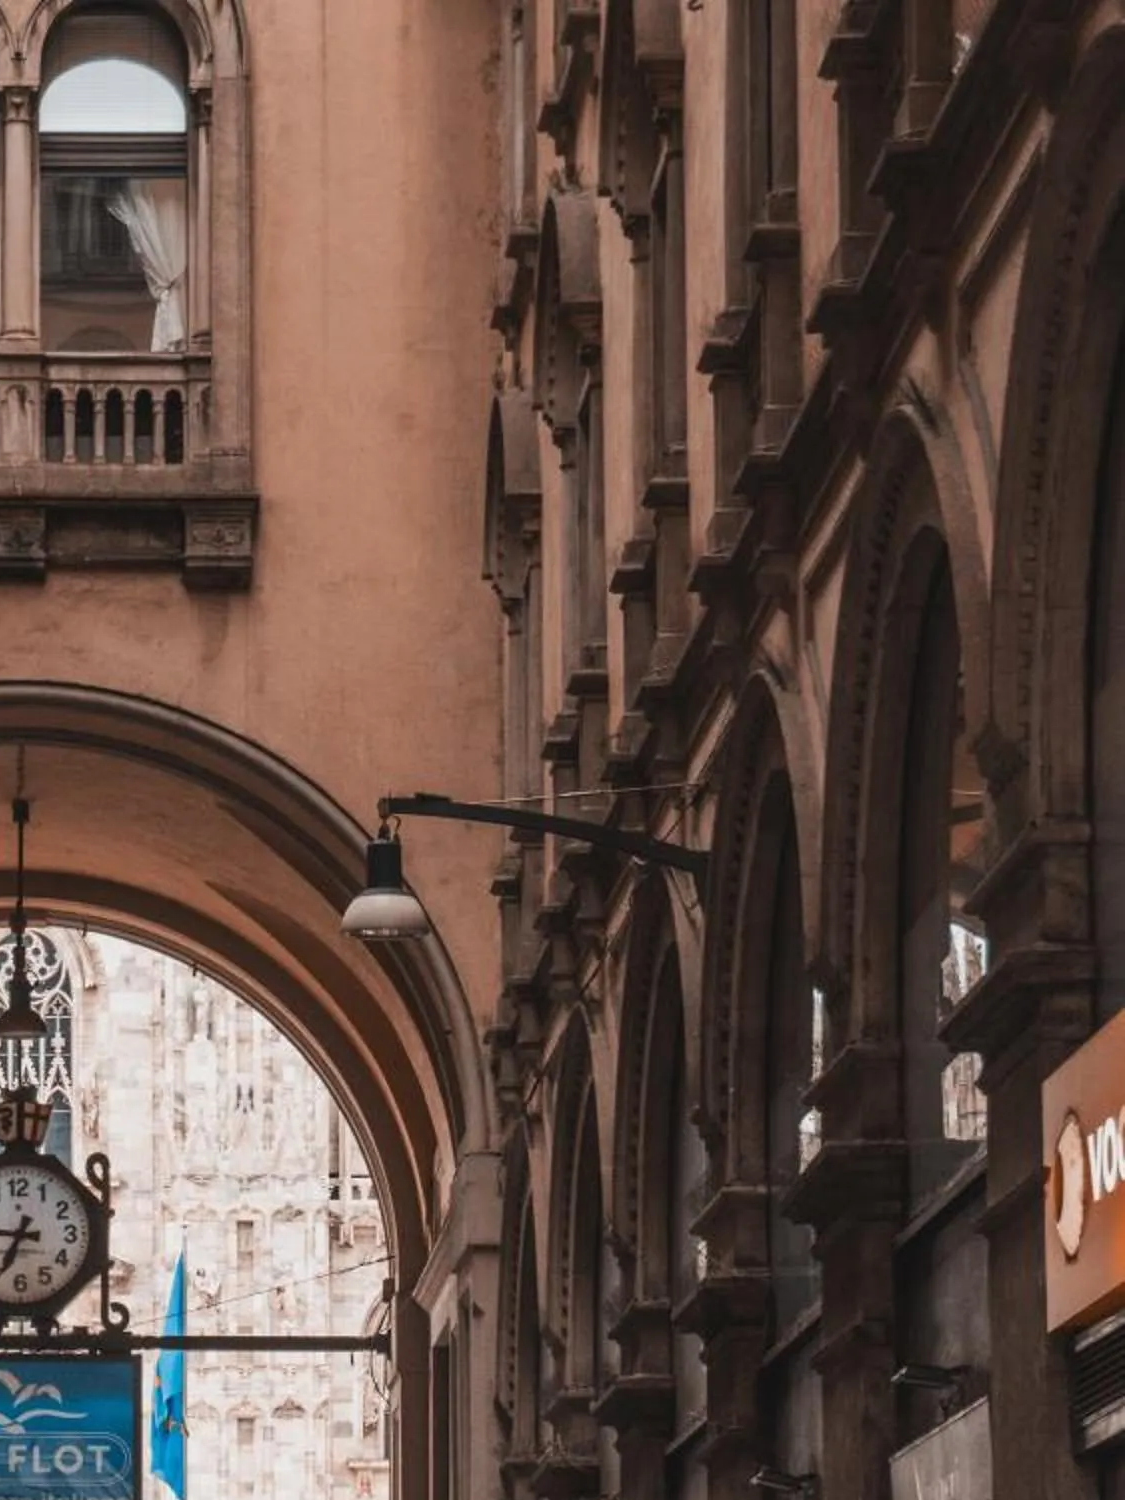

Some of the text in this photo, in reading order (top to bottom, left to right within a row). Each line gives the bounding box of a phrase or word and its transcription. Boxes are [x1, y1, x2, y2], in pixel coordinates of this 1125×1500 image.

[8, 1178, 28, 1197] 12
[38, 1183, 46, 1201] 1
[56, 1200, 69, 1220] 2
[64, 1224, 78, 1243] 3
[55, 1249, 69, 1267] 4
[14, 1274, 27, 1292] 6
[38, 1266, 52, 1285] 5
[8, 1444, 111, 1474] FLOT
